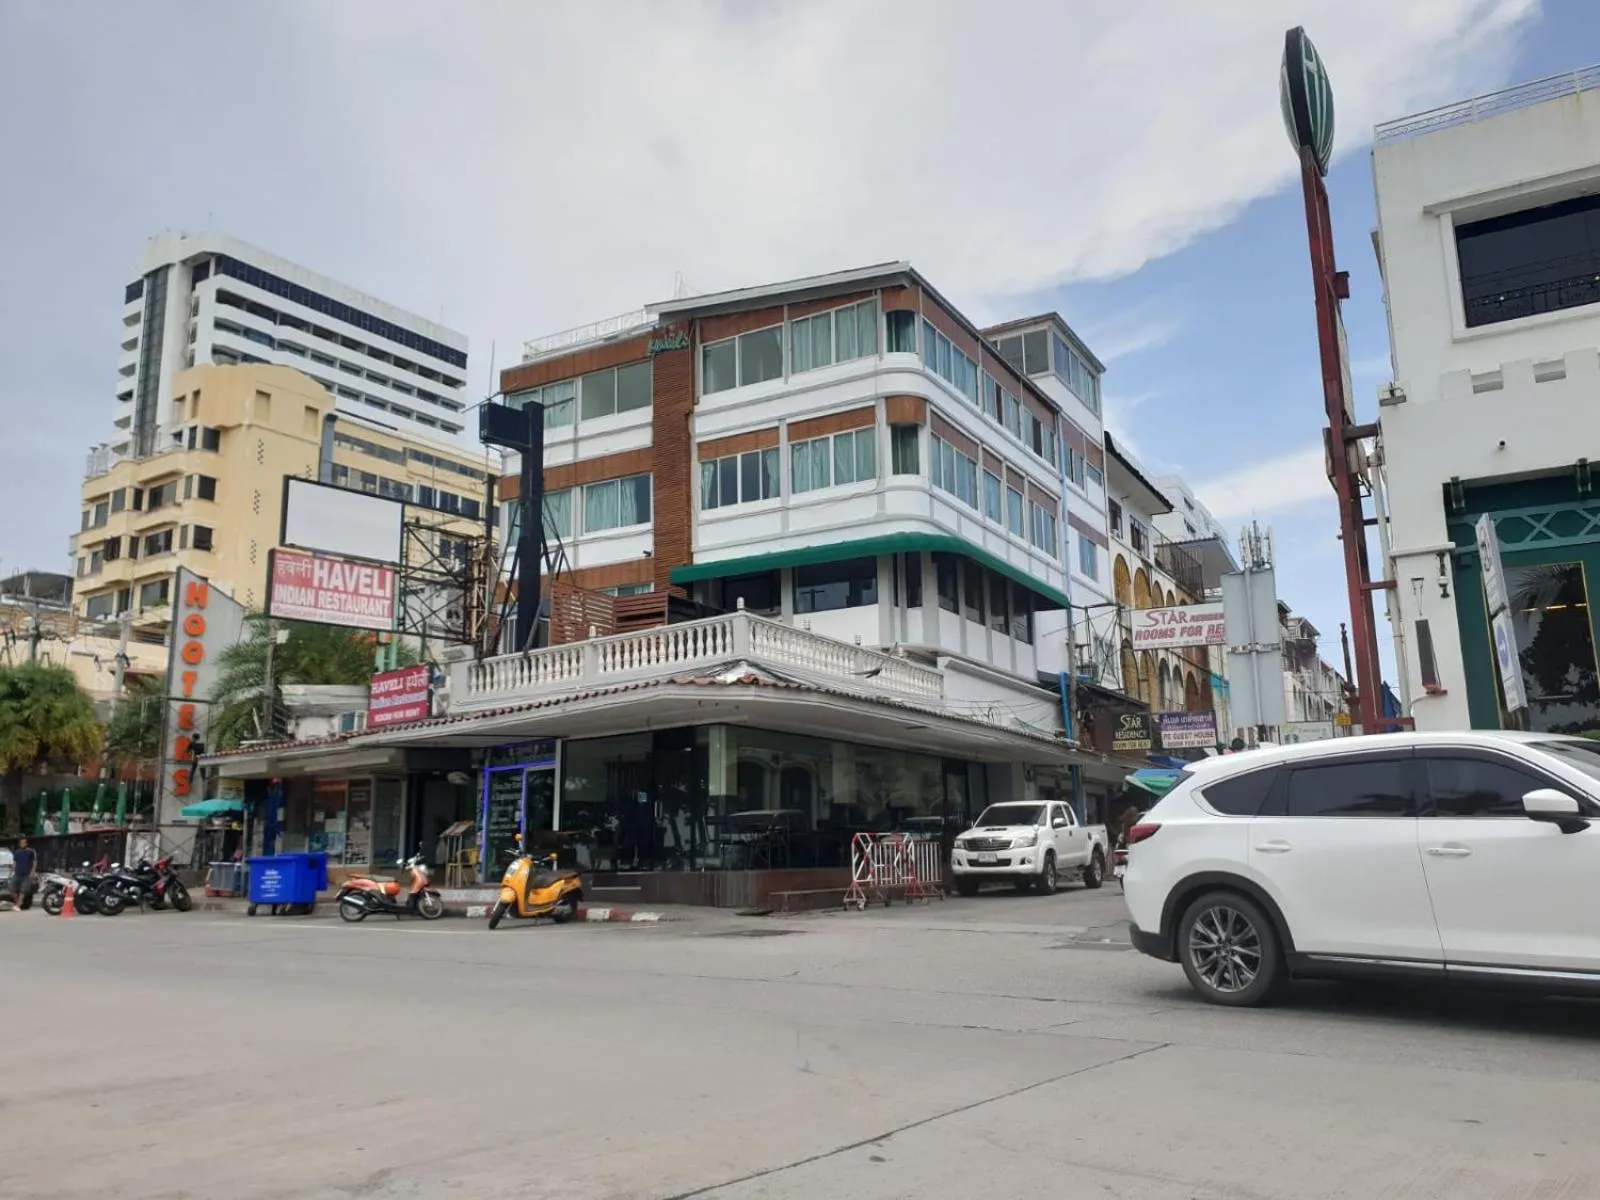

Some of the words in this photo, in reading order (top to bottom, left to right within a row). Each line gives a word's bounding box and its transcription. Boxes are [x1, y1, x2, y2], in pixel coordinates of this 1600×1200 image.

[313, 559, 393, 598] HAVELI
[274, 584, 315, 607] INDIAN
[317, 592, 392, 618] RESTAURANT
[1136, 610, 1188, 627] STAR
[1135, 627, 1176, 641] ROOMS
[1180, 625, 1203, 637] FOR
[1207, 623, 1226, 637] RE
[173, 581, 208, 798] HOOTERS
[371, 677, 404, 694] HAVELI
[1120, 714, 1142, 731] STAR
